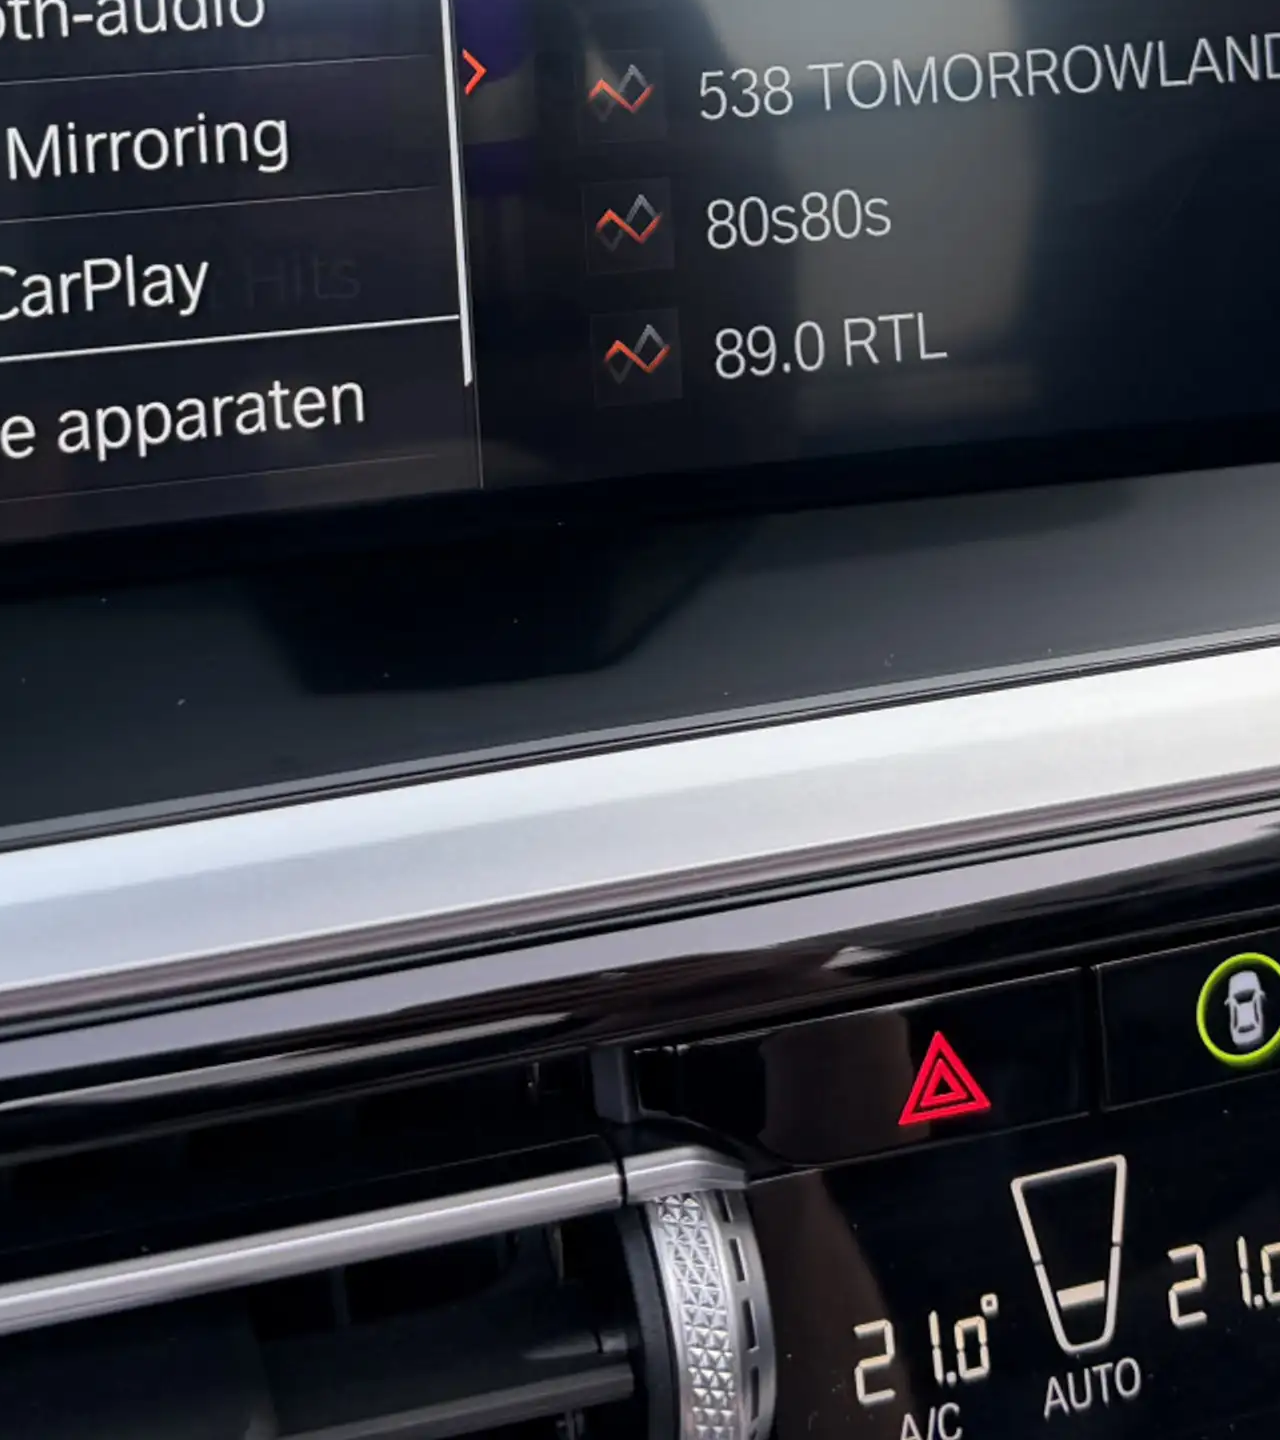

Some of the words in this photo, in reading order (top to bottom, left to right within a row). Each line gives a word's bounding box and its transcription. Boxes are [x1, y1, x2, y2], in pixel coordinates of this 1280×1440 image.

[701, 67, 792, 120] 538
[8, 113, 287, 179] Mirroring
[708, 190, 890, 249] 80s80s
[716, 322, 824, 379] 89.0
[844, 313, 947, 366] RTL
[58, 381, 363, 461] apparaten
[1043, 1357, 1141, 1418] AUTO
[901, 1403, 962, 1440] A/C
